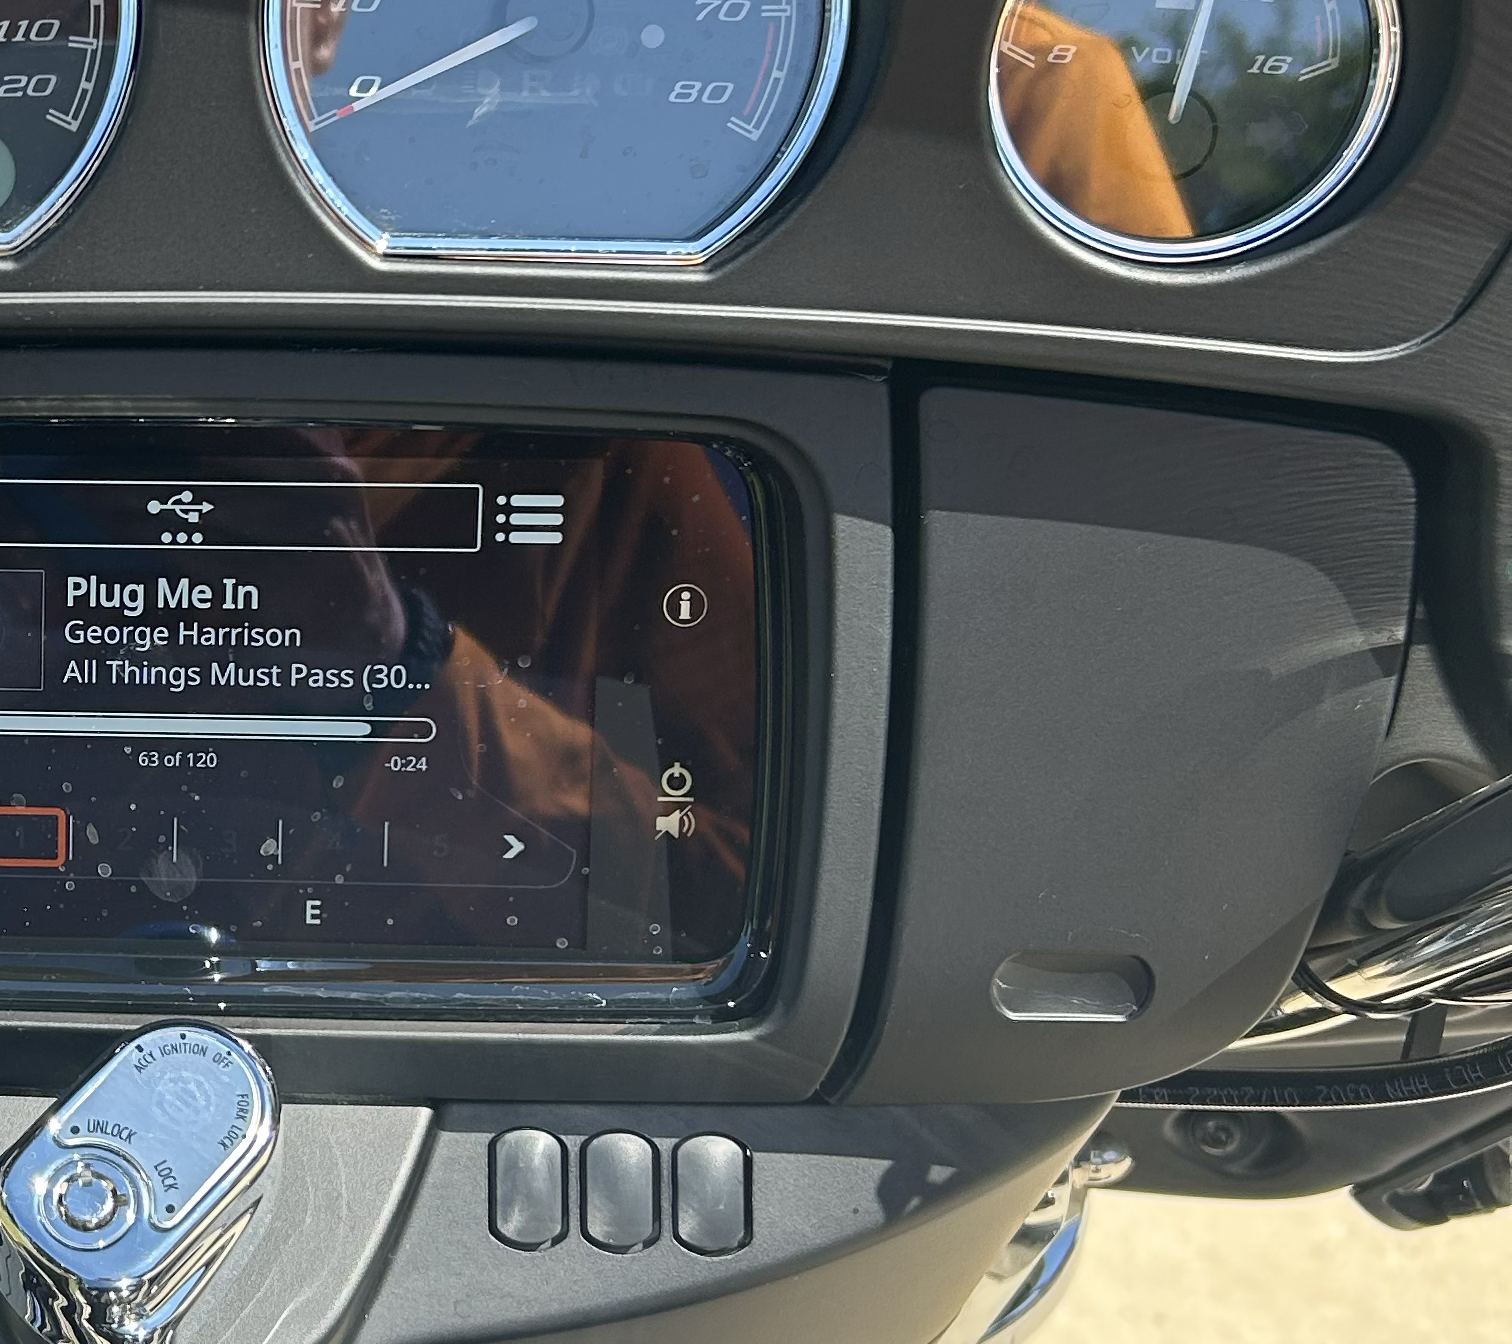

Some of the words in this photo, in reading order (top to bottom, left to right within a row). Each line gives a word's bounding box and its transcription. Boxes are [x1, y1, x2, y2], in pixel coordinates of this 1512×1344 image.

[693, 0, 750, 22] 70
[1047, 45, 1077, 64] 8
[1247, 55, 1293, 75] 16
[348, 76, 381, 97] 0
[668, 81, 734, 104] 80
[66, 575, 146, 617] Plug
[157, 579, 213, 610] Me
[222, 579, 260, 610] In
[64, 621, 169, 650] George
[178, 622, 302, 647] Harrison
[63, 661, 98, 685] All
[106, 661, 201, 692] Things
[210, 663, 281, 688] Must
[290, 664, 354, 689] Pass
[137, 752, 159, 768] 63
[163, 752, 183, 768] of
[186, 752, 218, 769] 120
[384, 756, 428, 773] -0:24
[305, 901, 322, 925] E
[158, 1043, 209, 1058] IGNITION
[212, 1053, 233, 1070] OFF
[134, 1050, 158, 1075] ACCY
[234, 1093, 249, 1122] FORK
[87, 1118, 137, 1145] UNLOCK
[217, 1124, 242, 1152] LOCK
[153, 1159, 180, 1193] LOCK
